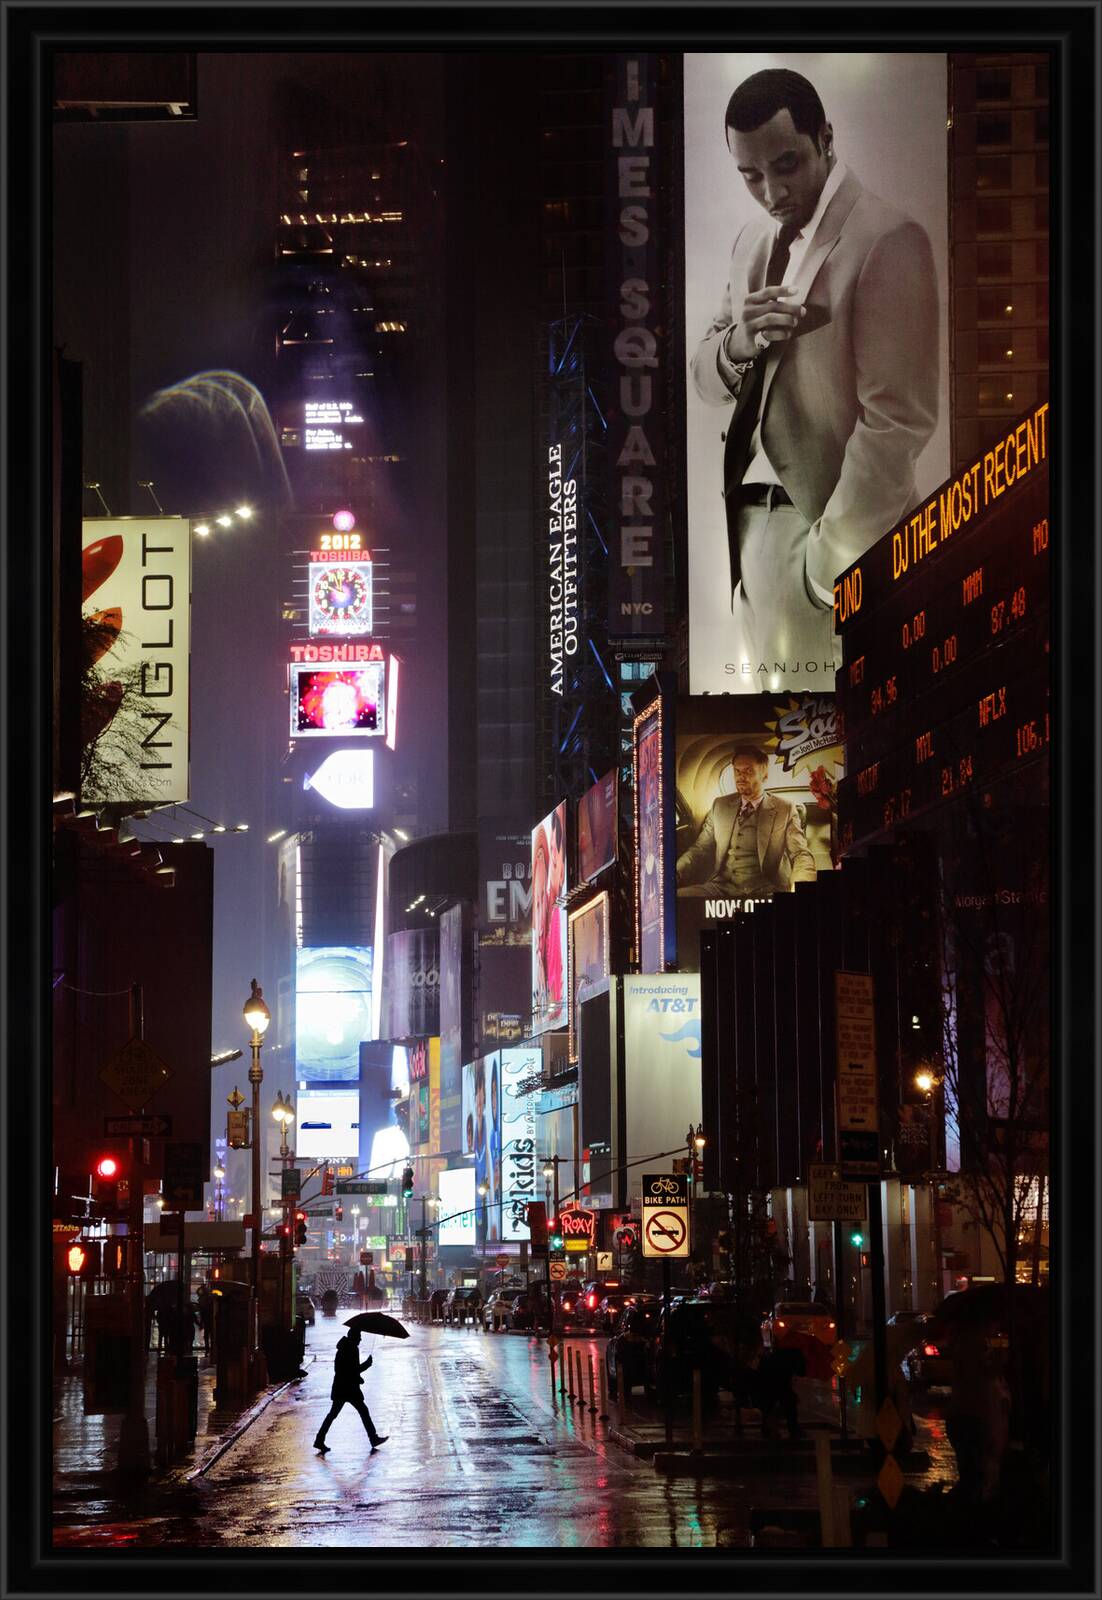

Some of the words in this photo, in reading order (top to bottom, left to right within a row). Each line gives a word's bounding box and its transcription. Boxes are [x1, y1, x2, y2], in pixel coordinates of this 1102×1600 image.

[613, 277, 659, 569] SQUARE
[548, 443, 562, 535] EAGLE
[832, 567, 863, 625] FUND
[892, 525, 909, 580] DJ
[910, 500, 937, 564] THE
[940, 462, 981, 542] MOST
[984, 402, 1049, 506] RECENT
[320, 535, 361, 550] 2012
[310, 550, 371, 561] TOSHIBA
[563, 478, 578, 655] OUTFITTERS
[621, 602, 654, 615] NYC
[549, 543, 564, 697] AMERICAN
[139, 533, 174, 770] INGLOT
[290, 645, 384, 661] TOSHIBA
[705, 899, 741, 918] NOW
[629, 985, 689, 996] Introducing
[647, 998, 698, 1013] AT&T
[644, 1196, 663, 1204] BIKE
[665, 1196, 686, 1204] PATH
